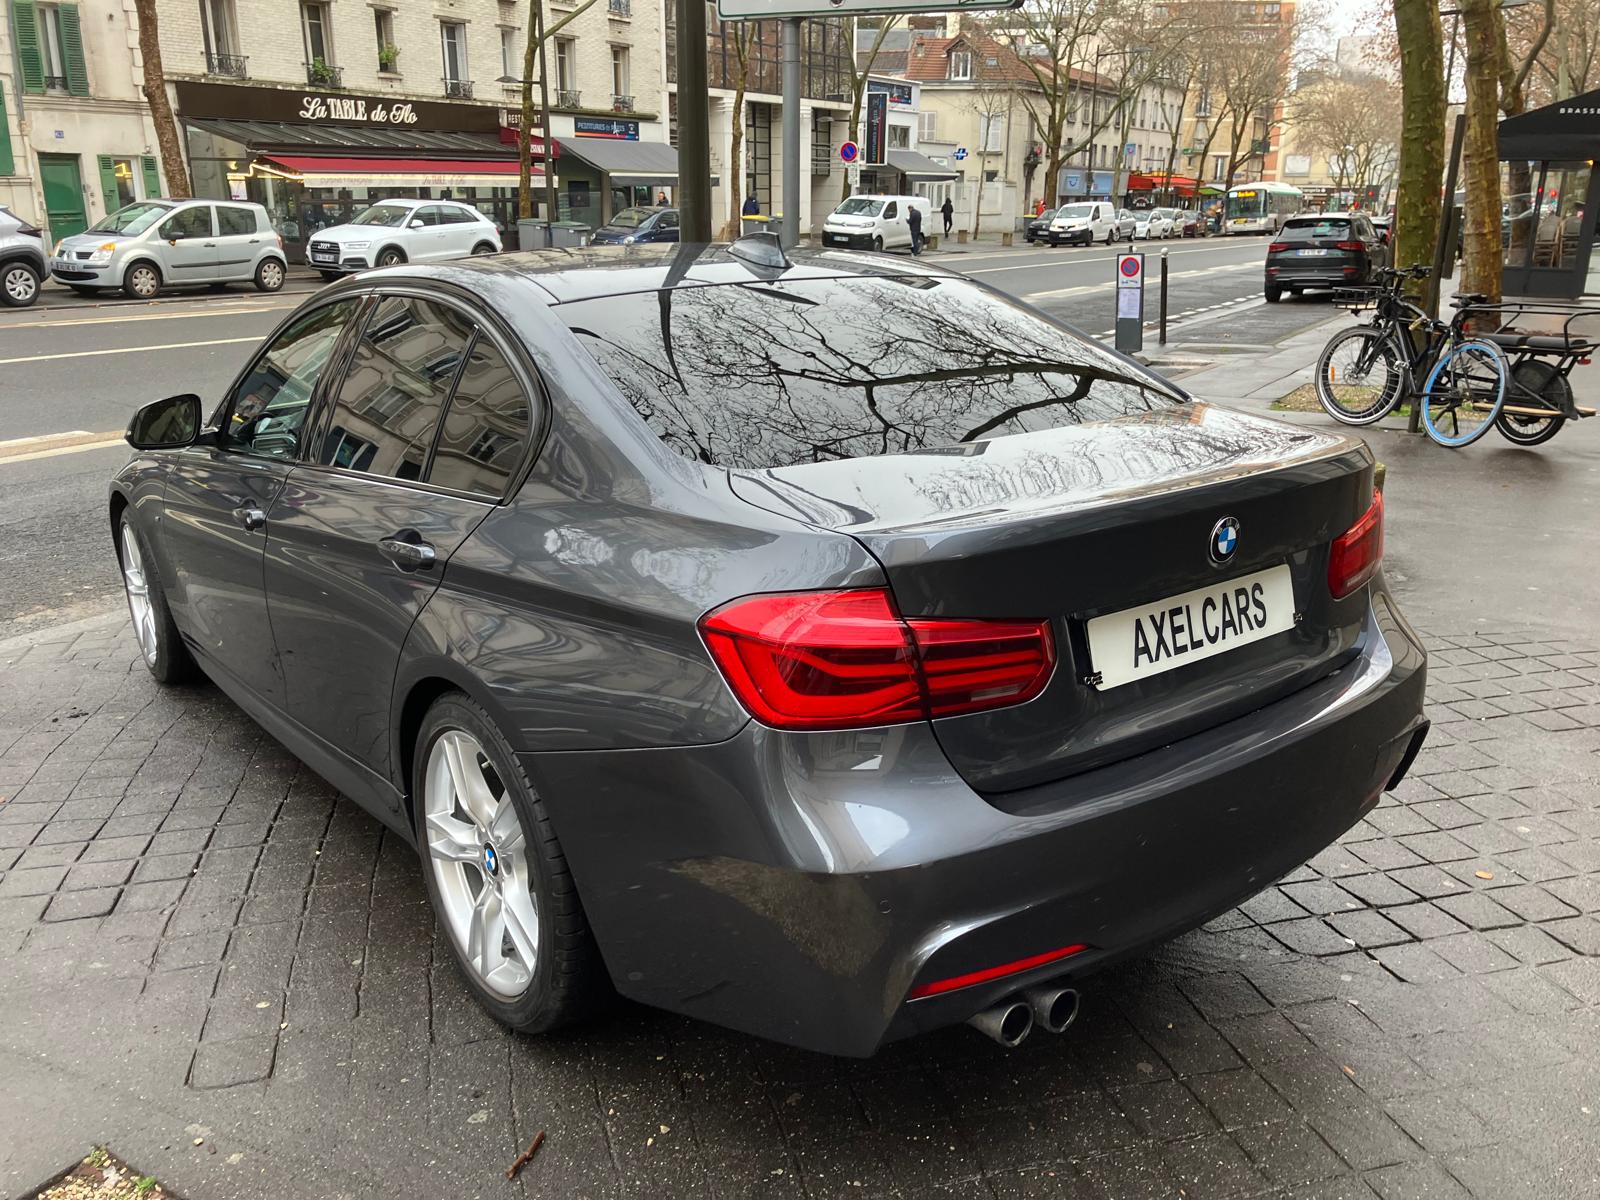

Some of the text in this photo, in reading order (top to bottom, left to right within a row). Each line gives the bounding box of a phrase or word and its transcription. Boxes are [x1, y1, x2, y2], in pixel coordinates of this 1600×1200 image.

[299, 97, 418, 123] La TABLE de Flo
[1134, 582, 1267, 668] AXELCARS
